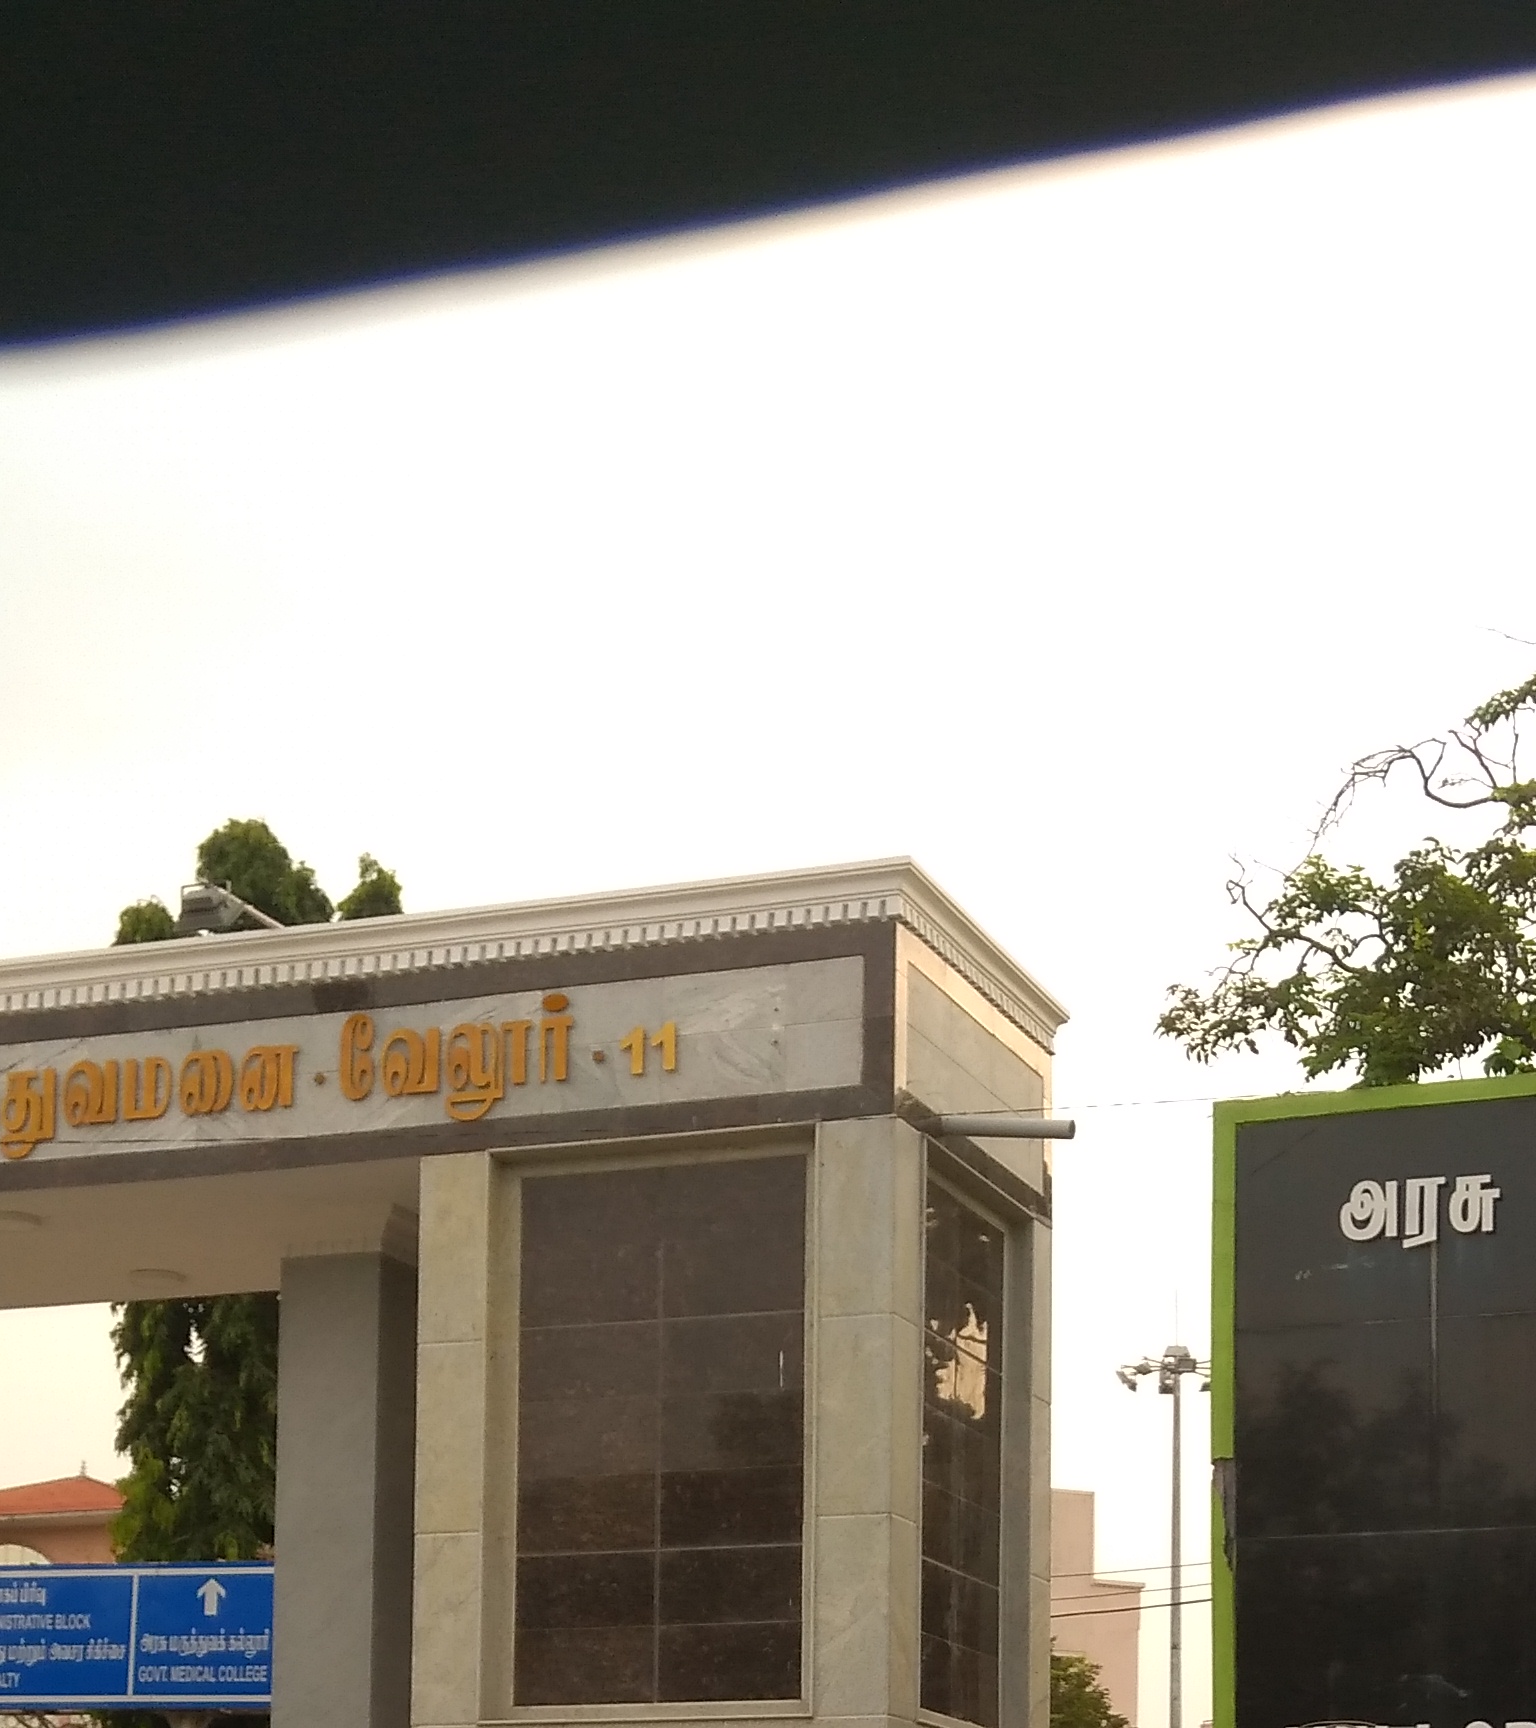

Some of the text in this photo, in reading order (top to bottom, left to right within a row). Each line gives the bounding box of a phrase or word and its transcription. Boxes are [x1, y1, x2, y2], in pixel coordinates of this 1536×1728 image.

[338, 993, 574, 1122] வேலூர்
[1340, 1172, 1504, 1250] அரசு
[55, 1613, 91, 1630] BLOCK
[169, 1665, 216, 1683] MEDICAL
[218, 1664, 268, 1682] COLLEGE
